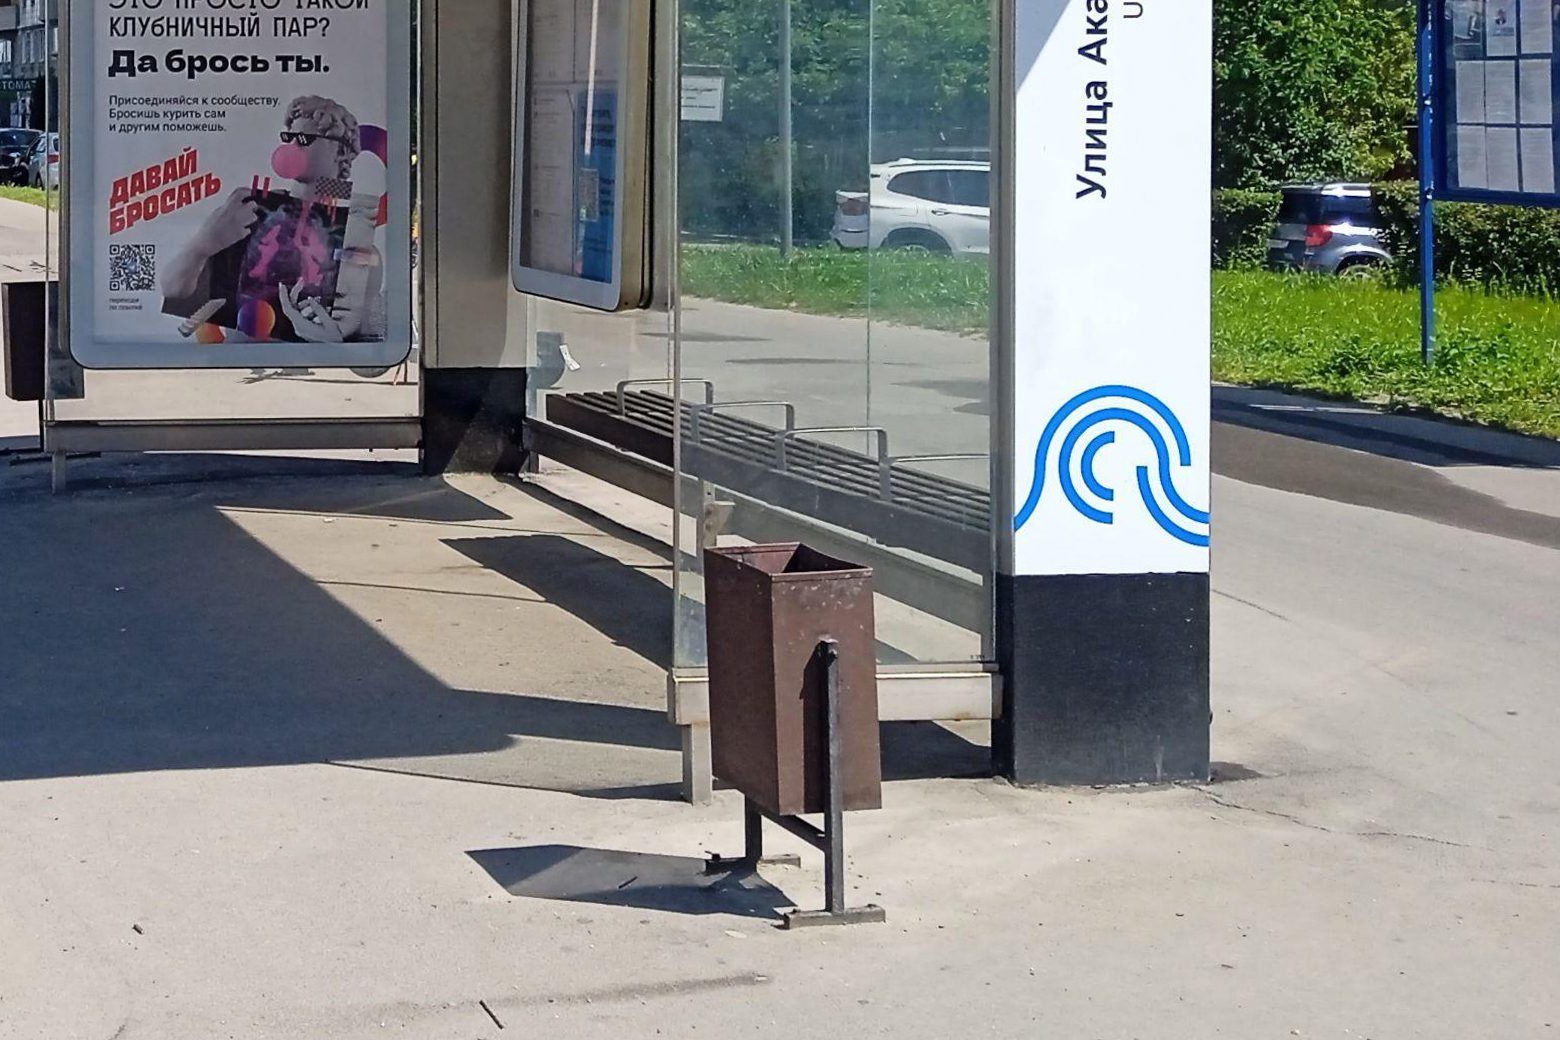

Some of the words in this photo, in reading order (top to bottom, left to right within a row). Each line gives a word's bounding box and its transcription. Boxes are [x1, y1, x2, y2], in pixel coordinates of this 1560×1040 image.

[273, 16, 331, 38] ПАР?
[108, 49, 159, 78] Да
[165, 49, 270, 79] брось
[275, 54, 330, 74] ты.
[109, 94, 199, 108] Присоединяйся
[202, 97, 209, 106] к
[109, 108, 161, 121] Бросишь
[163, 110, 202, 121] курить
[204, 110, 226, 119] сам
[109, 123, 117, 132] и
[118, 123, 160, 135] другим
[162, 123, 227, 133] поможешь.
[1075, 80, 1114, 199] Улица
[109, 146, 199, 210] ДАВАЙ
[109, 172, 223, 235] БРОСАТЬ
